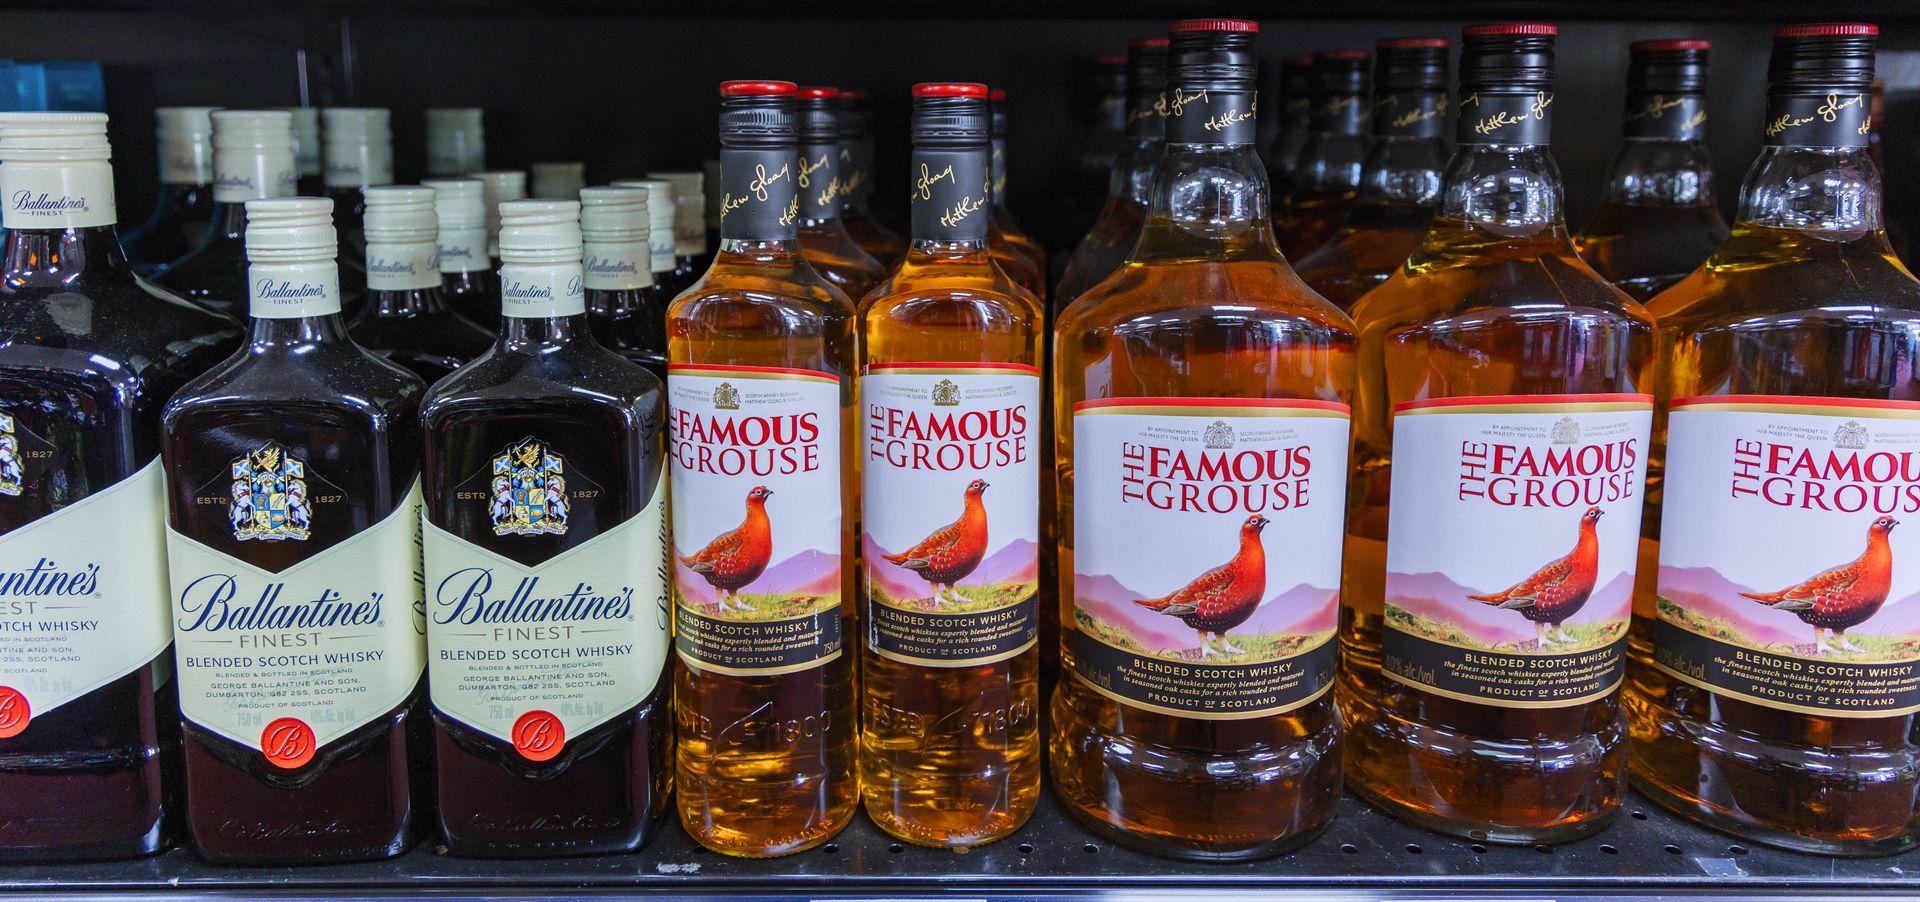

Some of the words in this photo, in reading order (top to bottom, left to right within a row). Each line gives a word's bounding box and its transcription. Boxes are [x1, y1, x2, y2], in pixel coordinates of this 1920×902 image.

[12, 189, 86, 210] Ballantine's
[585, 255, 636, 274] Ballantine's
[256, 277, 326, 298] Ballantine's
[502, 277, 552, 298] Ballantine's
[679, 412, 819, 446] FAMOUS
[871, 404, 885, 461] THE
[886, 405, 1027, 441] FAMOUS
[26, 450, 53, 459] 1827
[678, 442, 819, 477] GROUSE
[885, 436, 1026, 471] GROUSE
[1147, 445, 1311, 483] FAMOUS
[1490, 438, 1637, 477] FAMOUS
[1122, 442, 1144, 503] THE
[1459, 440, 1488, 501] THE
[1731, 438, 1762, 498] THE
[1146, 478, 1310, 514] GROUSE
[1487, 470, 1635, 508] GROUSE
[178, 574, 384, 632] Ballantine's
[433, 567, 634, 625] Ballantine's
[38, 621, 98, 631] WHISKY
[715, 624, 759, 636] SCOTCH
[765, 621, 809, 635] WHISKY
[880, 609, 924, 625] BLENDED
[929, 618, 975, 627] SCOTCH
[980, 609, 1018, 625] WHISKY
[240, 632, 322, 649] FINEST
[494, 626, 574, 641] FINEST
[186, 657, 253, 668] BLENDED
[259, 655, 319, 667] SCOTCH
[324, 650, 384, 664] WHISKY
[440, 650, 506, 661] BLENDED
[512, 648, 570, 660] SCOTCH
[576, 644, 633, 657] WHISKY
[691, 647, 721, 660] PRODUCT
[736, 655, 784, 663] SCOTLAND
[899, 644, 936, 654] PRODUCT
[953, 644, 997, 655] SCOTLAND
[1465, 653, 1525, 668] BLENDED
[1530, 658, 1576, 668] SCOTCH
[1580, 648, 1613, 665] WHISKY
[310, 668, 353, 676] SCOTLAND
[561, 661, 603, 669] SCOTLAND
[1134, 658, 1189, 676] BLENDED
[1194, 669, 1245, 679] SCOTCH
[1249, 662, 1292, 678] WHISKY
[1714, 657, 1726, 665] the
[1727, 660, 1751, 671] finest
[1753, 667, 1780, 678] scotch
[1782, 673, 1818, 683] whiskies
[1821, 679, 1854, 687] expertly
[1736, 651, 1802, 671] BLENDED
[1808, 664, 1863, 677] SCOTCH
[1868, 666, 1913, 677] WHISKY
[251, 680, 310, 689] BALLANTINE
[504, 673, 561, 681] BALLANTINE
[565, 680, 615, 688] SCOTLAND
[1117, 665, 1126, 673] the
[1128, 668, 1147, 679] finest
[1148, 674, 1171, 684] scotch
[1173, 679, 1204, 688] whiskies
[1238, 679, 1266, 687] blended
[1131, 677, 1163, 690] seasoned
[1164, 684, 1178, 692] oak
[1201, 689, 1213, 697] for
[1222, 688, 1237, 696] rich
[1239, 685, 1268, 695] rounded
[1732, 670, 1770, 683] seasoned
[1772, 677, 1788, 687] oak
[1814, 685, 1827, 693] for
[205, 691, 266, 699] DUMBARTON,
[314, 686, 367, 695] SCOTLAND
[1148, 692, 1200, 706] PRODUCT
[1220, 696, 1277, 708] SCOTLAND
[1479, 685, 1534, 697] PRODUCT
[1553, 682, 1600, 696] SCOTLAND
[1751, 685, 1811, 702] PRODUCT
[1835, 698, 1895, 706] SCOTLAND
